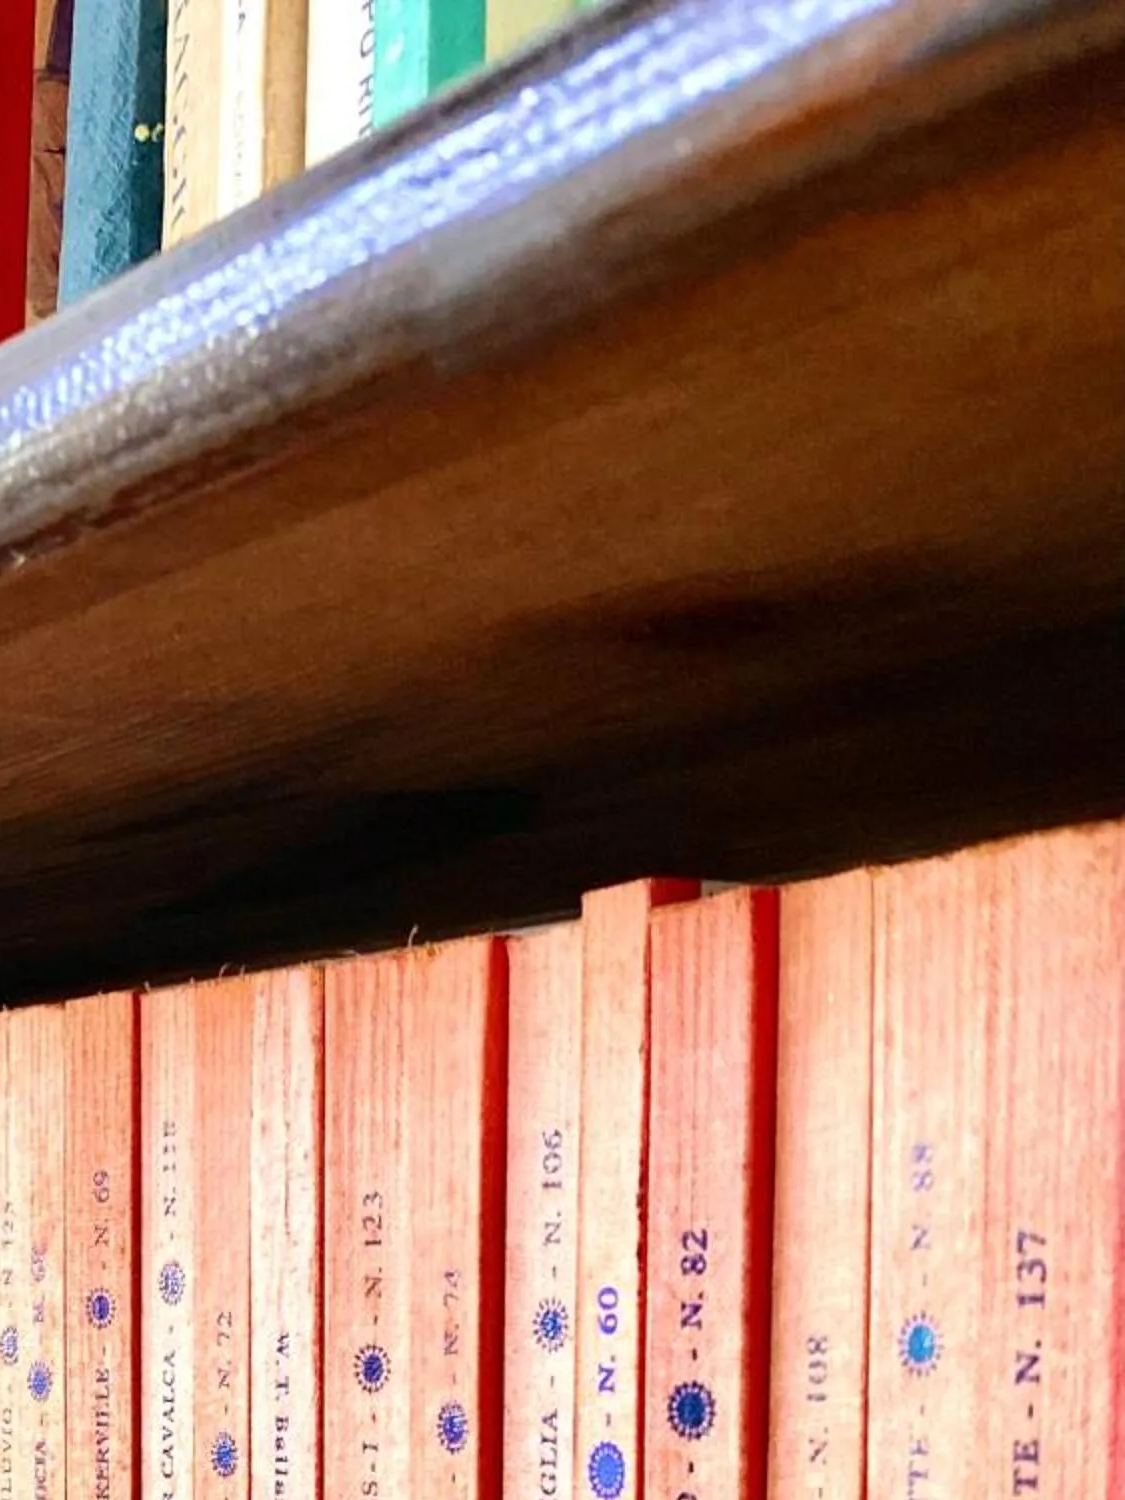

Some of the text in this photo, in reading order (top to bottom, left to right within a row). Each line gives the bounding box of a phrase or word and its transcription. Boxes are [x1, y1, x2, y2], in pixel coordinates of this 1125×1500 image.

[541, 1128, 563, 1190] 106
[92, 1169, 110, 1203] 69
[163, 1185, 176, 1217] N.
[94, 1218, 109, 1248] N.
[543, 1210, 562, 1247] N.
[680, 1228, 708, 1276] 82
[1015, 1229, 1048, 1309] 137
[216, 1311, 233, 1346] 72
[597, 1286, 618, 1336] 60
[680, 1290, 704, 1331] N.
[443, 1323, 460, 1357] N.
[217, 1359, 232, 1390] N.
[598, 1354, 615, 1394] N.
[1014, 1338, 1042, 1384] N.
[275, 1375, 290, 1402] T.
[161, 1350, 175, 1479] CAVALCA
[808, 1426, 829, 1465] N.
